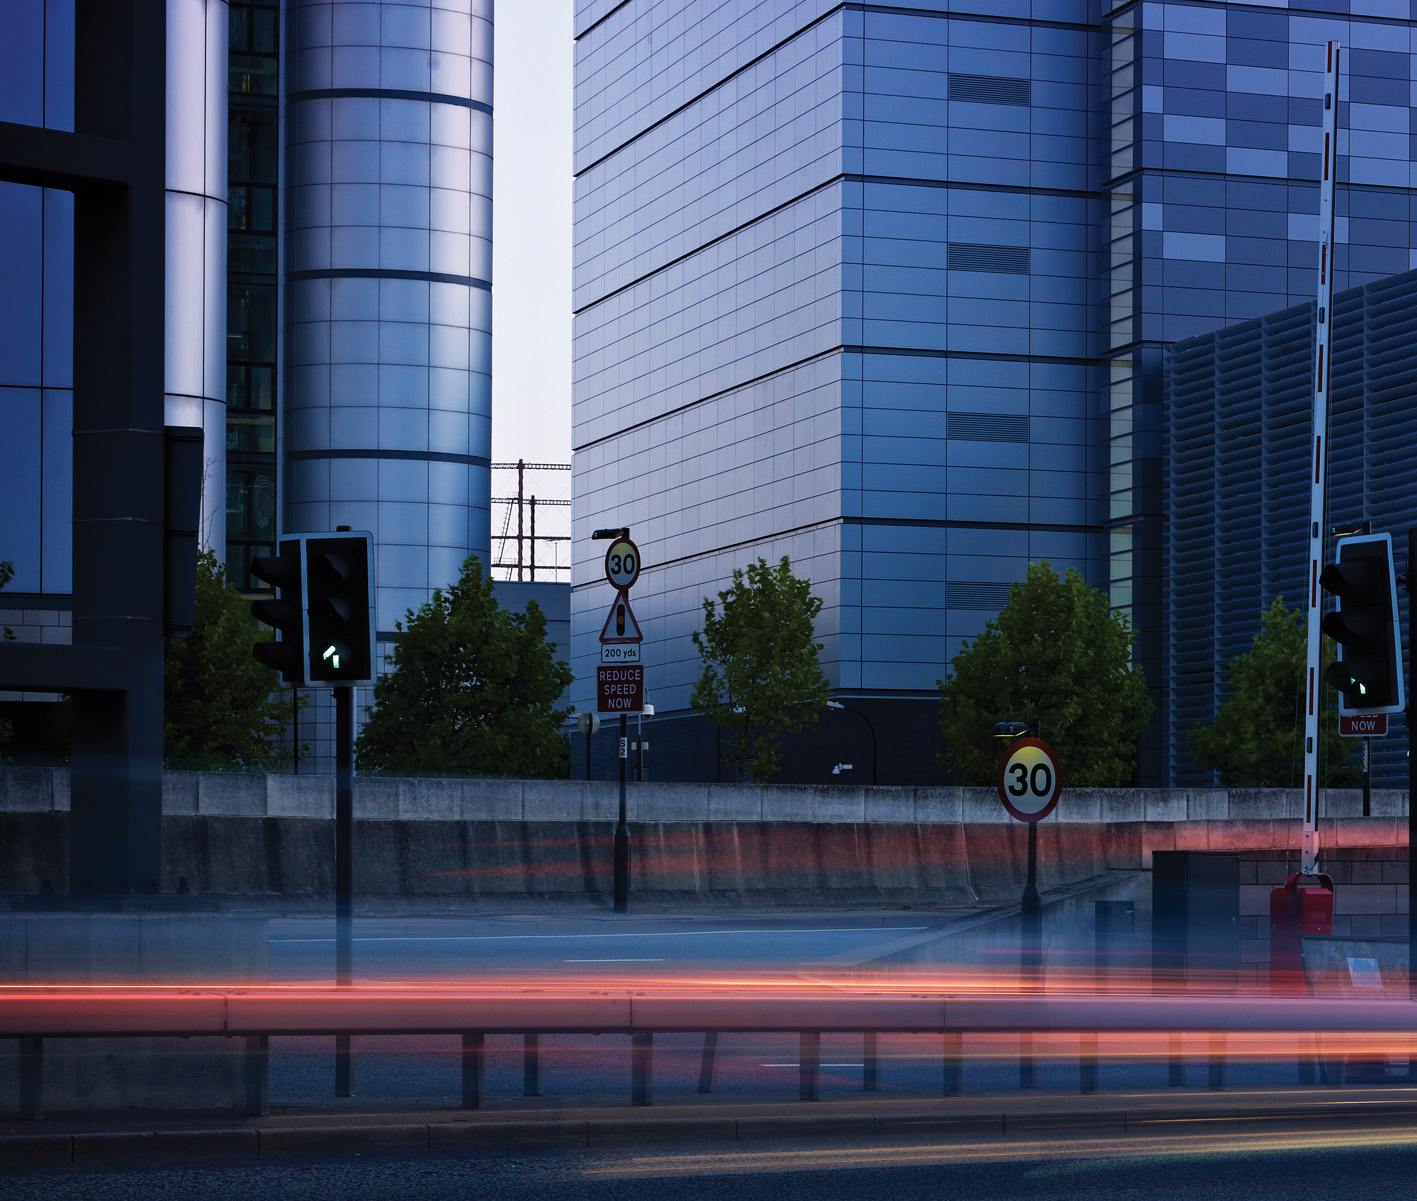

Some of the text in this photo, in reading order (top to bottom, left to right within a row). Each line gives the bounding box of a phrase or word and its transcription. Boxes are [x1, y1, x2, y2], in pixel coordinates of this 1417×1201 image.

[611, 554, 635, 575] 30
[604, 648, 637, 659] 200 yds
[599, 669, 641, 682] REDUCE
[604, 683, 637, 695] SPEED
[608, 698, 632, 709] NOW
[1351, 720, 1376, 731] NOW
[1008, 763, 1052, 797] 30
